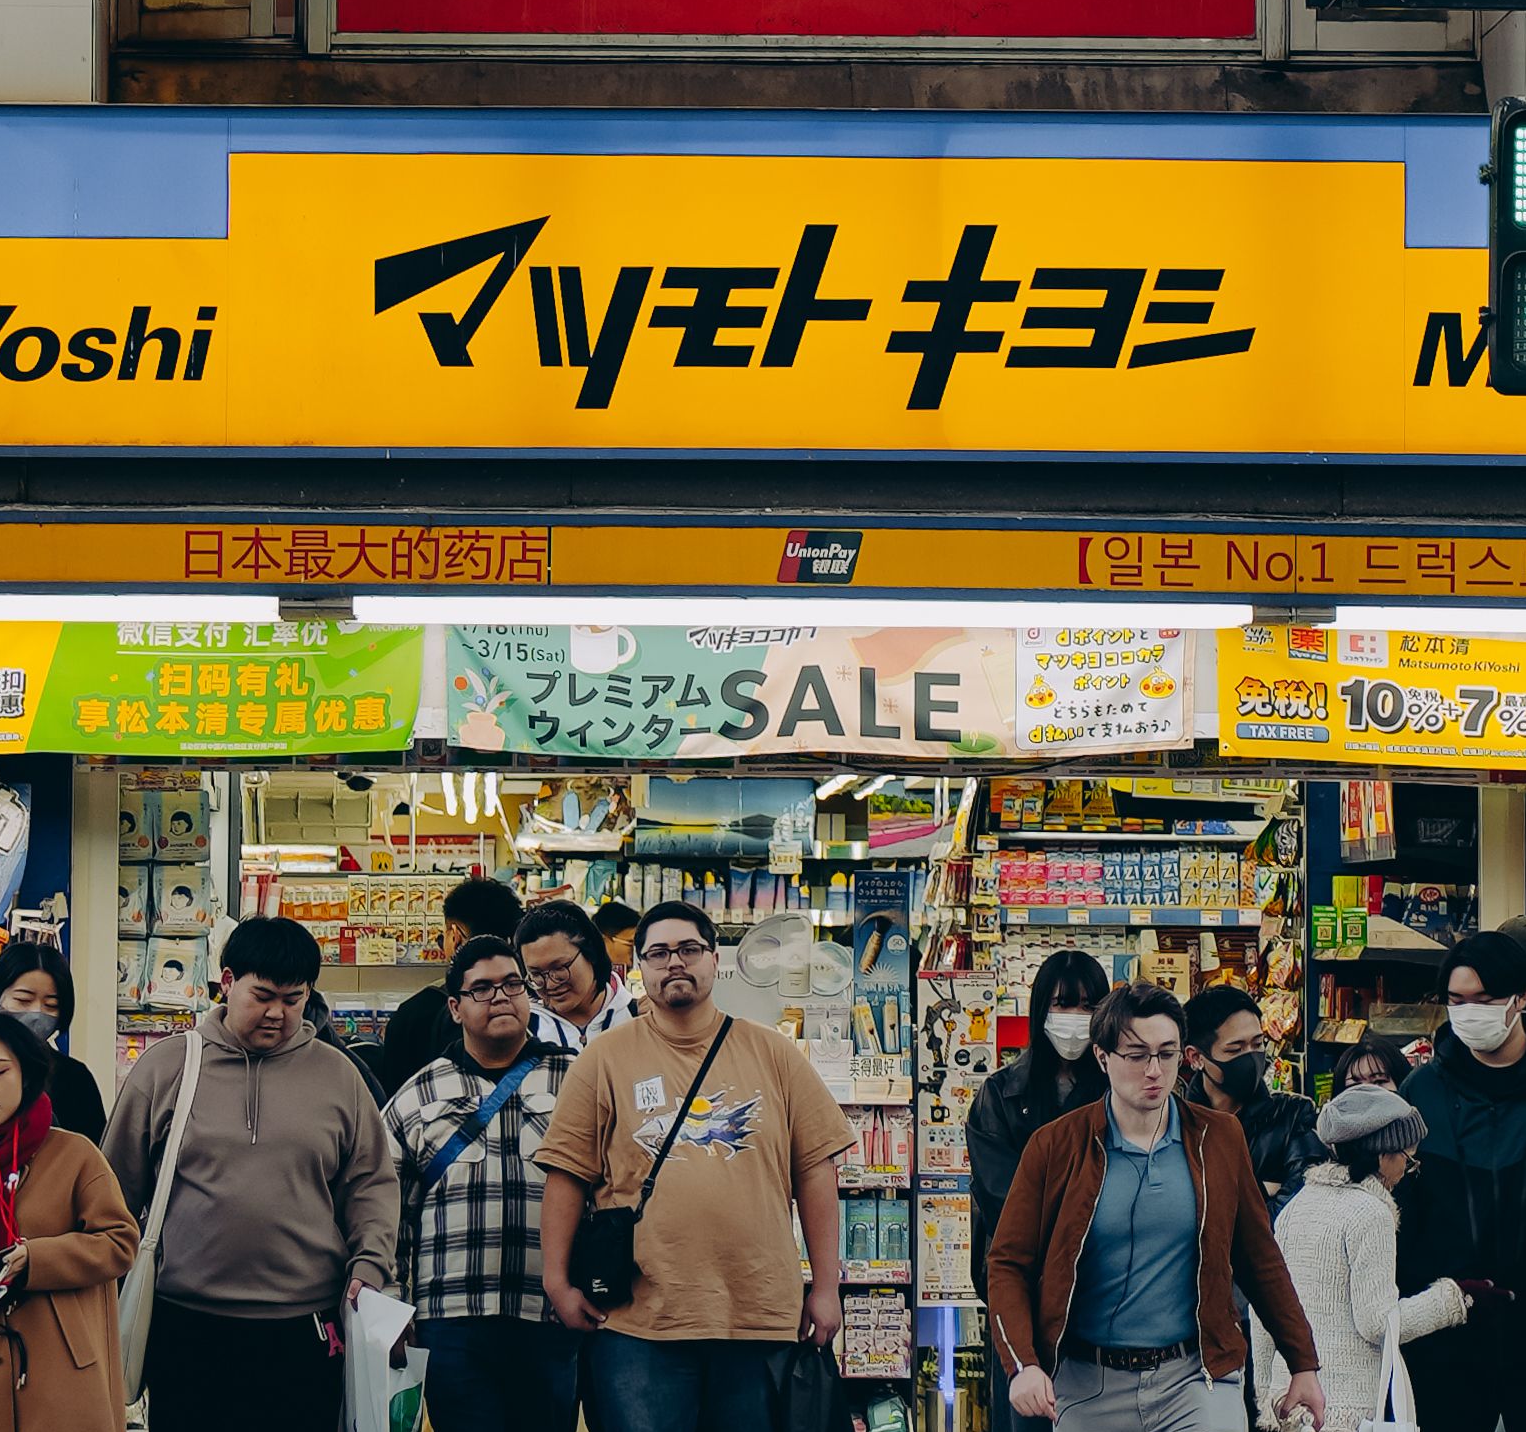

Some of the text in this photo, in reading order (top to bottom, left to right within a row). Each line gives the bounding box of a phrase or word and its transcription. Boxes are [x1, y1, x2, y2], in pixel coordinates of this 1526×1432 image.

[374, 214, 1256, 412] マツモトキヨシ
[183, 528, 549, 583] 日本最大的药店
[787, 543, 857, 566] UnionPay
[1225, 539, 1332, 584] No.1
[117, 622, 329, 648] 微信支付 汇率优
[1399, 634, 1470, 655] 松本清
[159, 661, 310, 698] 扫码有礼
[1398, 657, 1472, 672] Matsumoto
[526, 670, 712, 709] プレミアム
[719, 665, 961, 742] SALE
[76, 697, 387, 736] 享松本清专属优惠
[528, 711, 712, 751] ウィンター
[1249, 725, 1314, 740] TAX FREE
